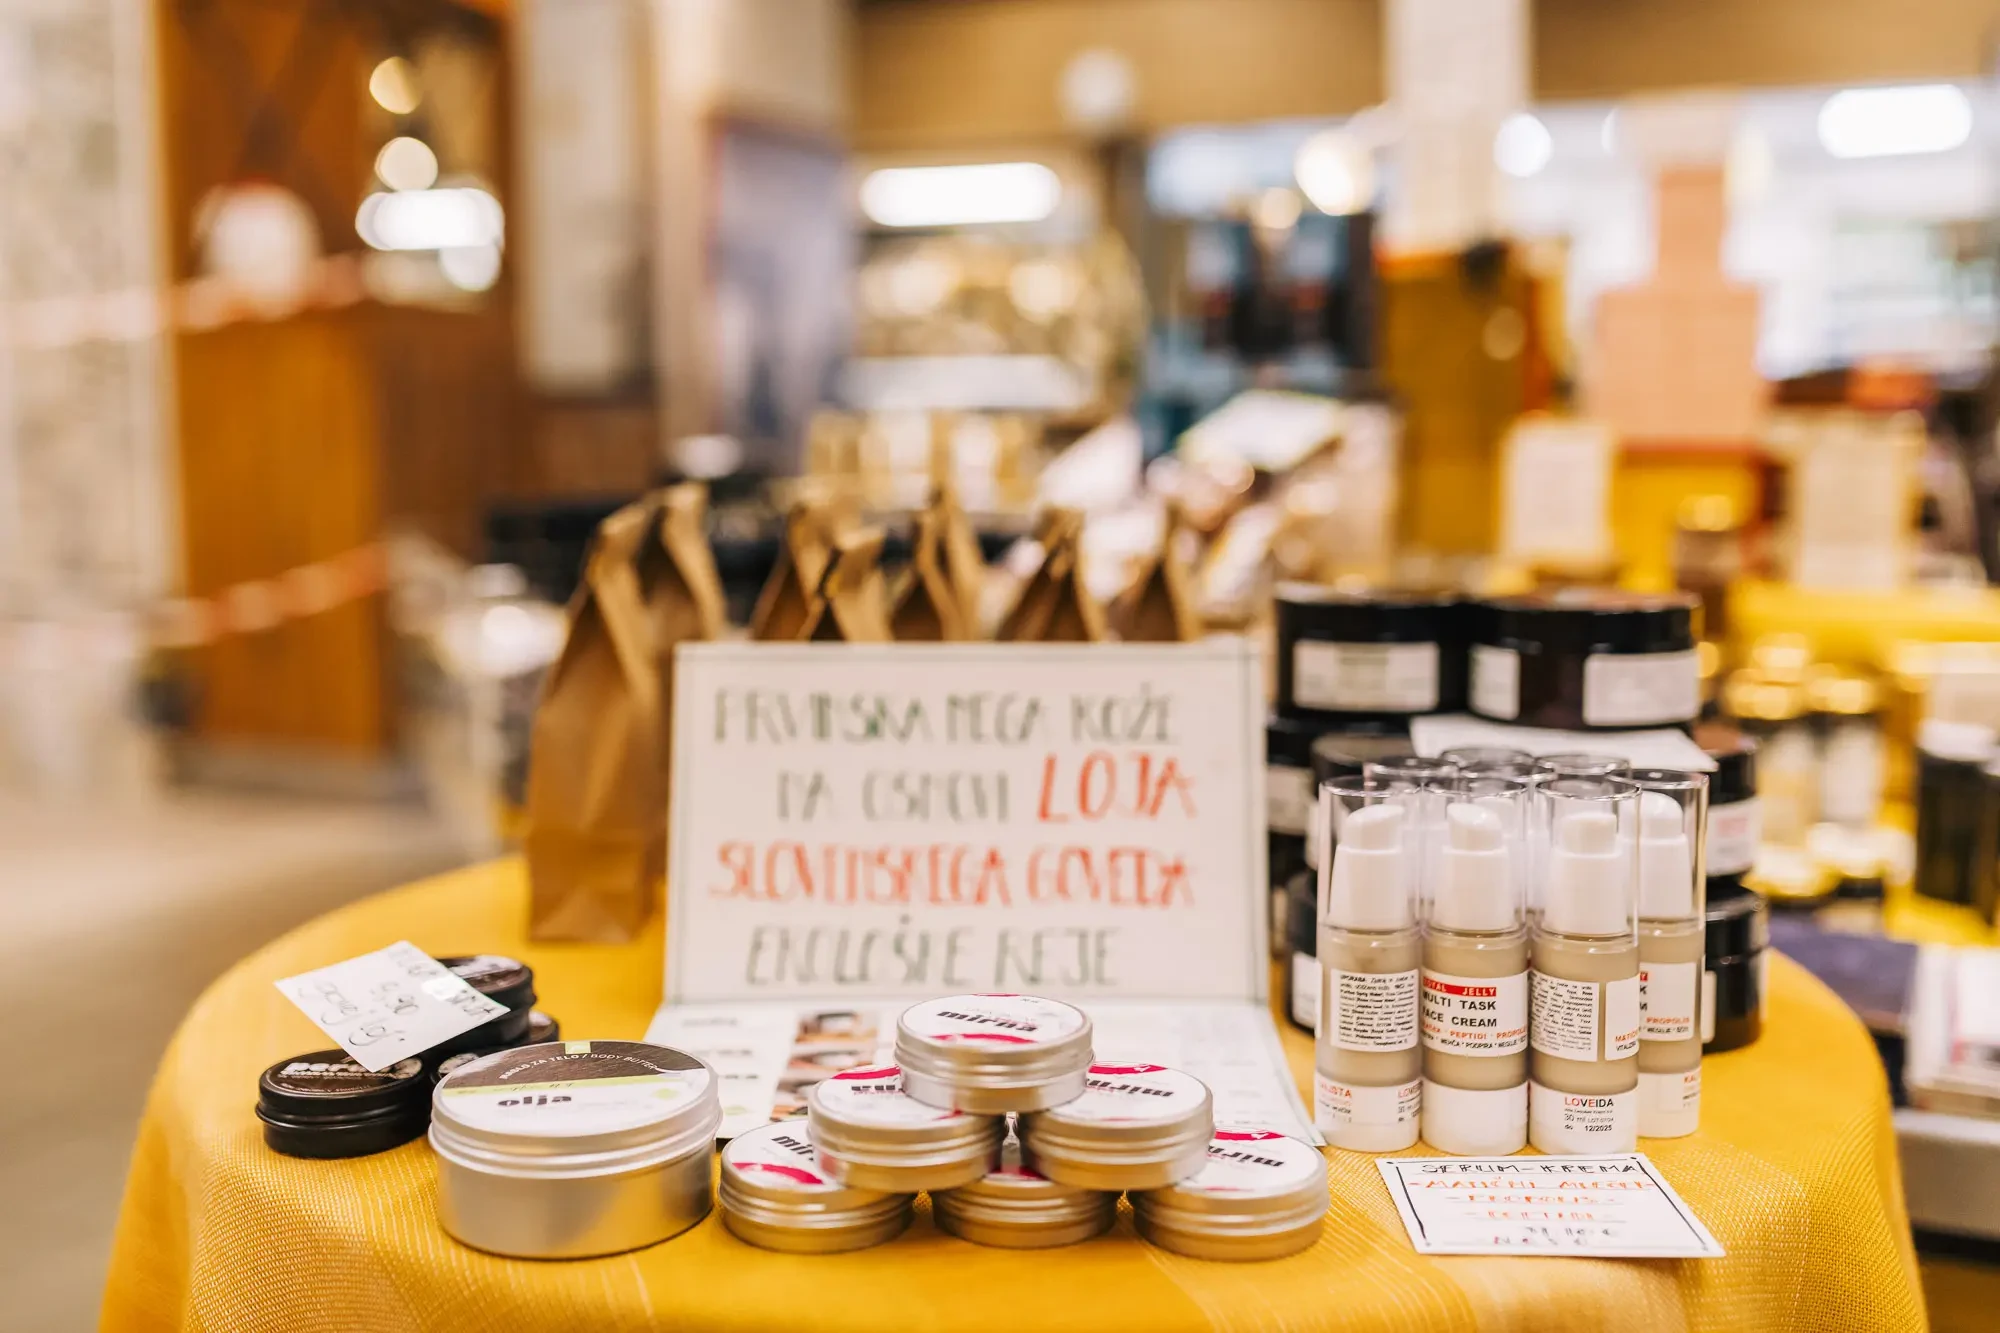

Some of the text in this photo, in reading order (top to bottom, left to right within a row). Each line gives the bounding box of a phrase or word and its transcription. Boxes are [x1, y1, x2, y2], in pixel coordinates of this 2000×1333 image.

[1036, 750, 1197, 824] LOJA
[1462, 987, 1496, 997] JELLY
[1459, 999, 1497, 1011] TASK
[937, 1010, 1039, 1032] mirna
[1451, 1016, 1498, 1028] CREAM
[1449, 1029, 1487, 1040] PEPTIDI
[531, 1059, 547, 1069] ZA
[550, 1054, 580, 1062] TELO
[624, 1056, 659, 1071] BUTTER
[497, 1094, 572, 1106] olja
[1564, 1096, 1614, 1108] LOVEIDA
[1584, 1124, 1613, 1132] 12/2025
